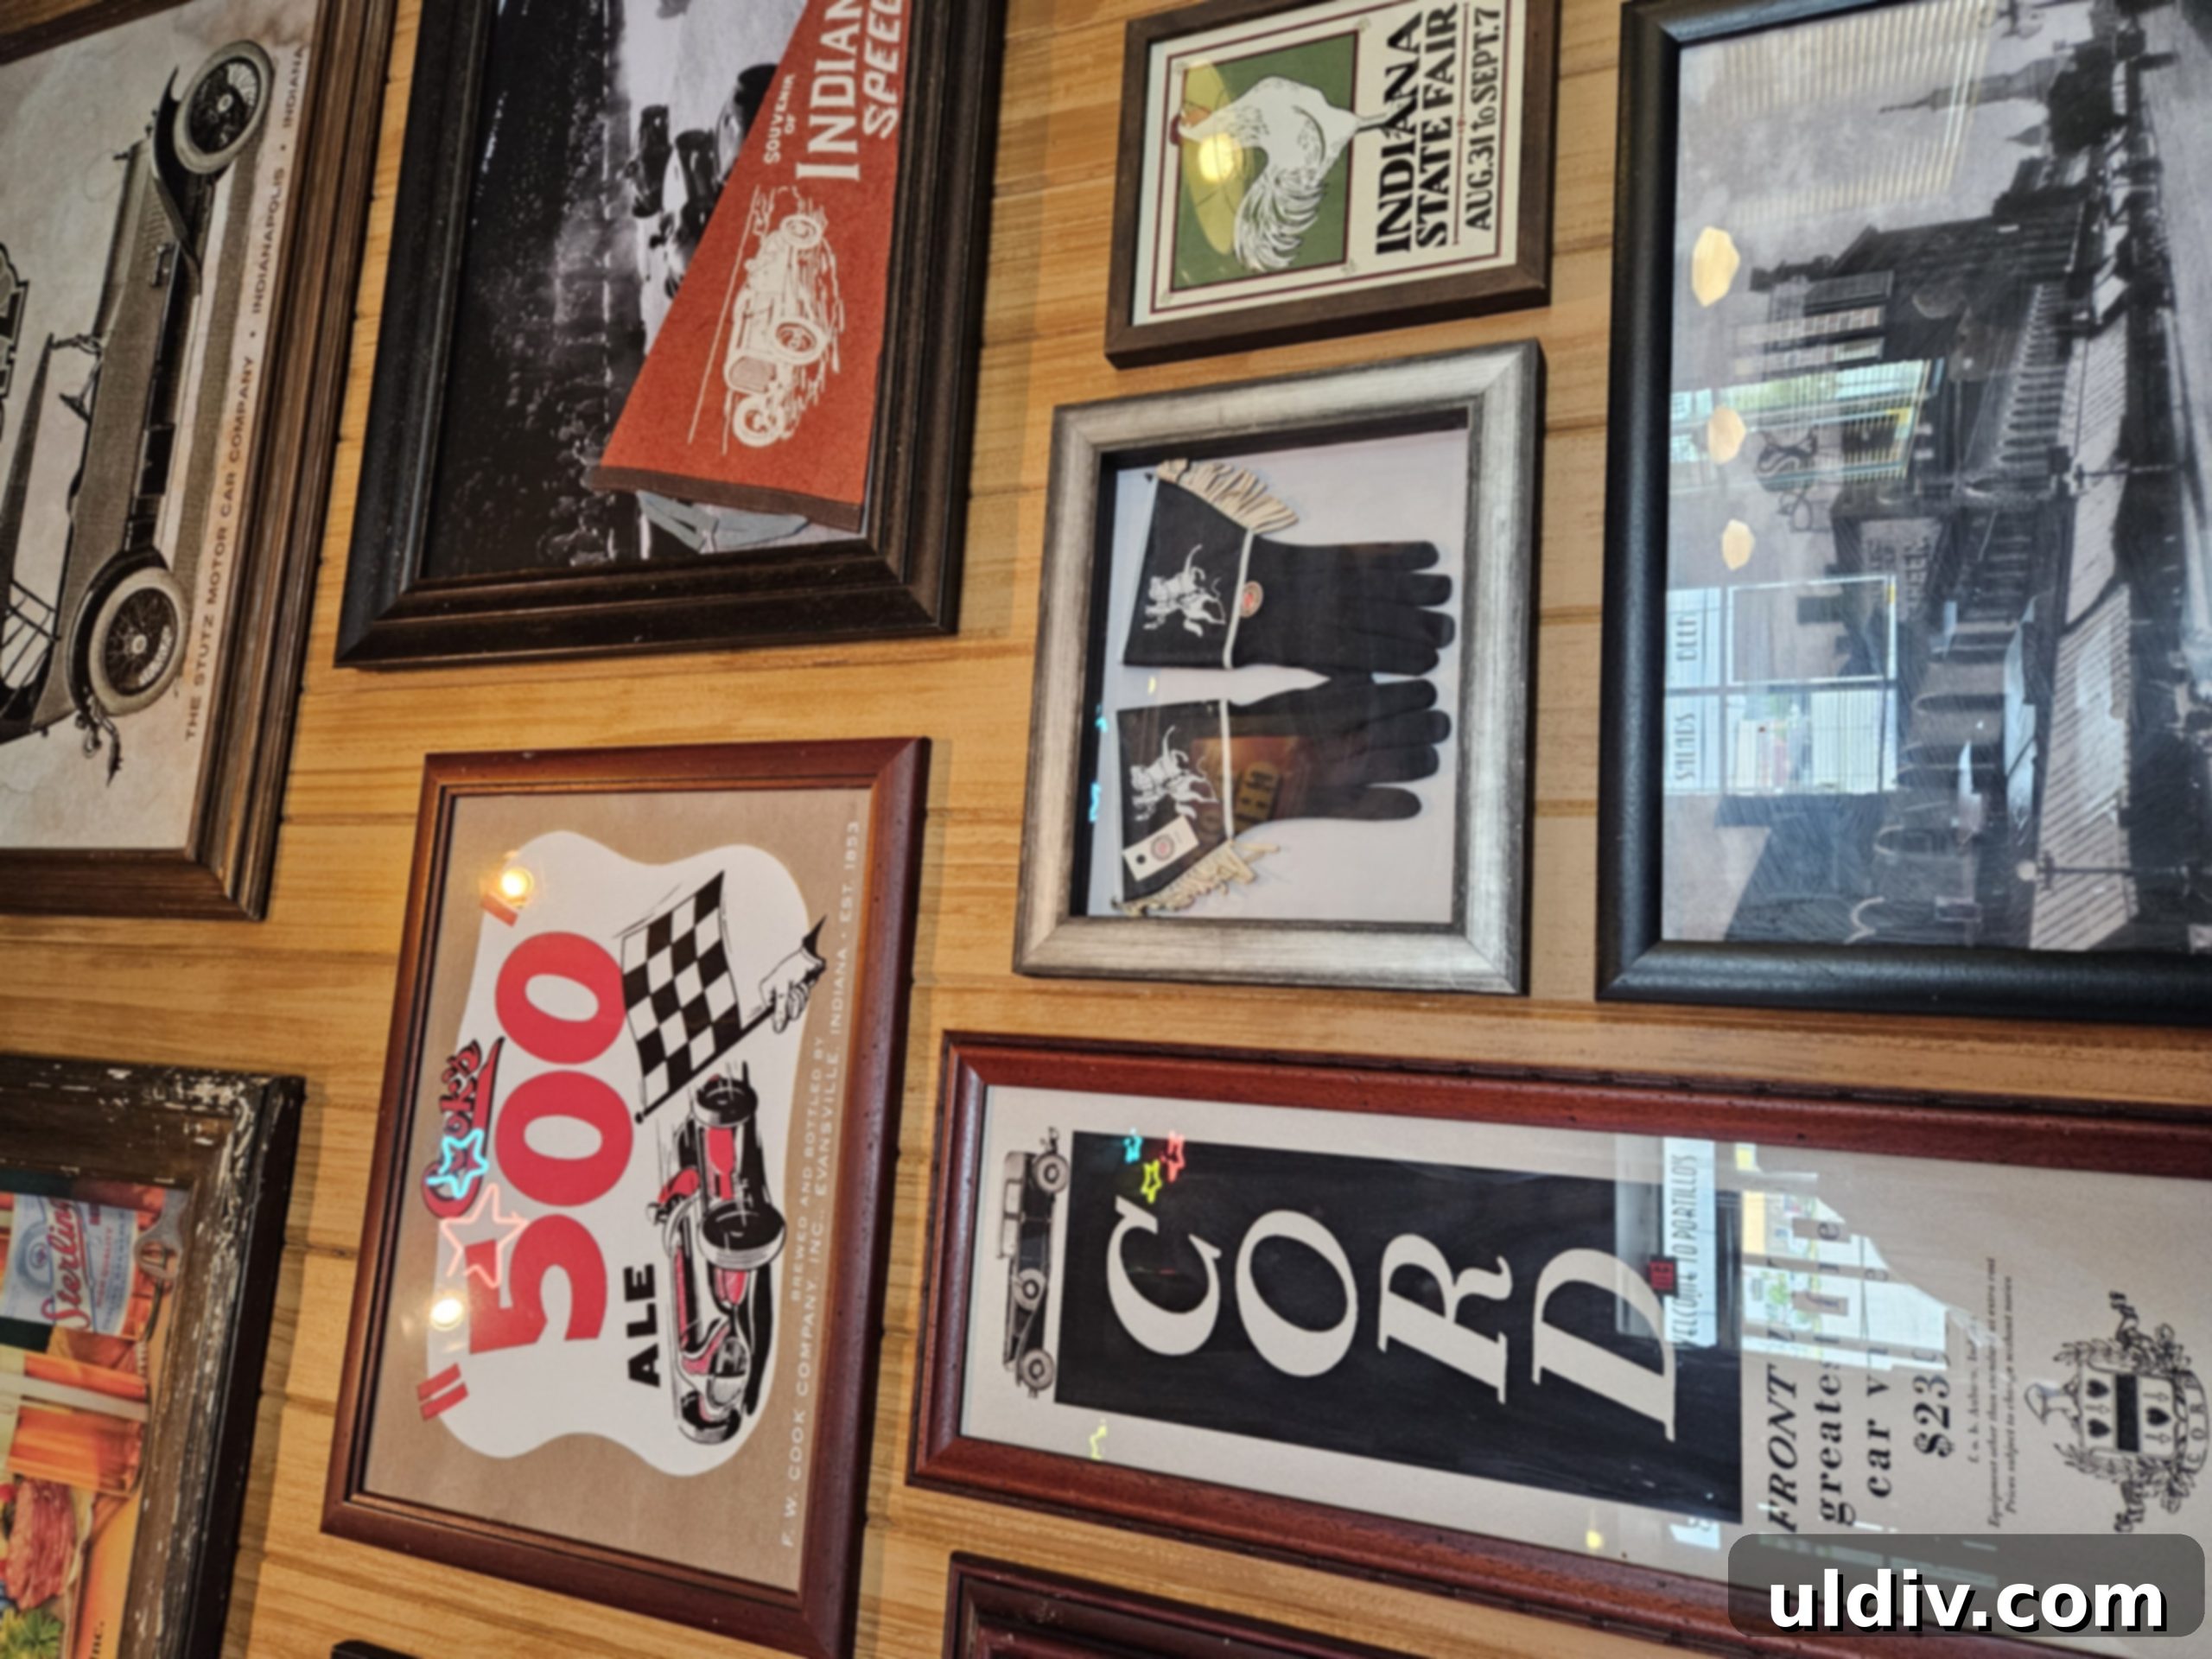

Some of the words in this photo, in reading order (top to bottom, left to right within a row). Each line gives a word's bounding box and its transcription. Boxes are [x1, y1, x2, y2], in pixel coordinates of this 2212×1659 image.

[1421, 2, 1459, 111] FAIR
[763, 73, 797, 164] SOUVENIR
[1374, 10, 1423, 257] INDIANA
[1471, 105, 1497, 132] to
[1414, 116, 1453, 249] STATE
[184, 694, 202, 743] THE
[193, 612, 214, 688] STUTZ
[206, 524, 227, 607] MOTOR
[219, 471, 237, 519] CAR
[228, 354, 254, 464] COMPANY
[251, 164, 285, 315] INDIANAPOLIS
[281, 42, 303, 129] INDIANA
[842, 820, 861, 871] 1853
[838, 878, 856, 925] EST.
[829, 947, 849, 1036] INDIANA
[812, 1035, 827, 1060] BY
[804, 1068, 824, 1158] BOTTLED
[798, 1166, 814, 1207] AND
[791, 1216, 810, 1302] BREWED
[623, 1262, 660, 1389] ALE
[785, 1408, 806, 1481] COOK
[1765, 1363, 1799, 1534] FRONT
[1866, 1419, 1892, 1499] car
[780, 1529, 796, 1548] F.
[783, 1491, 799, 1518] W.
[88, 1621, 105, 1659] nc.
